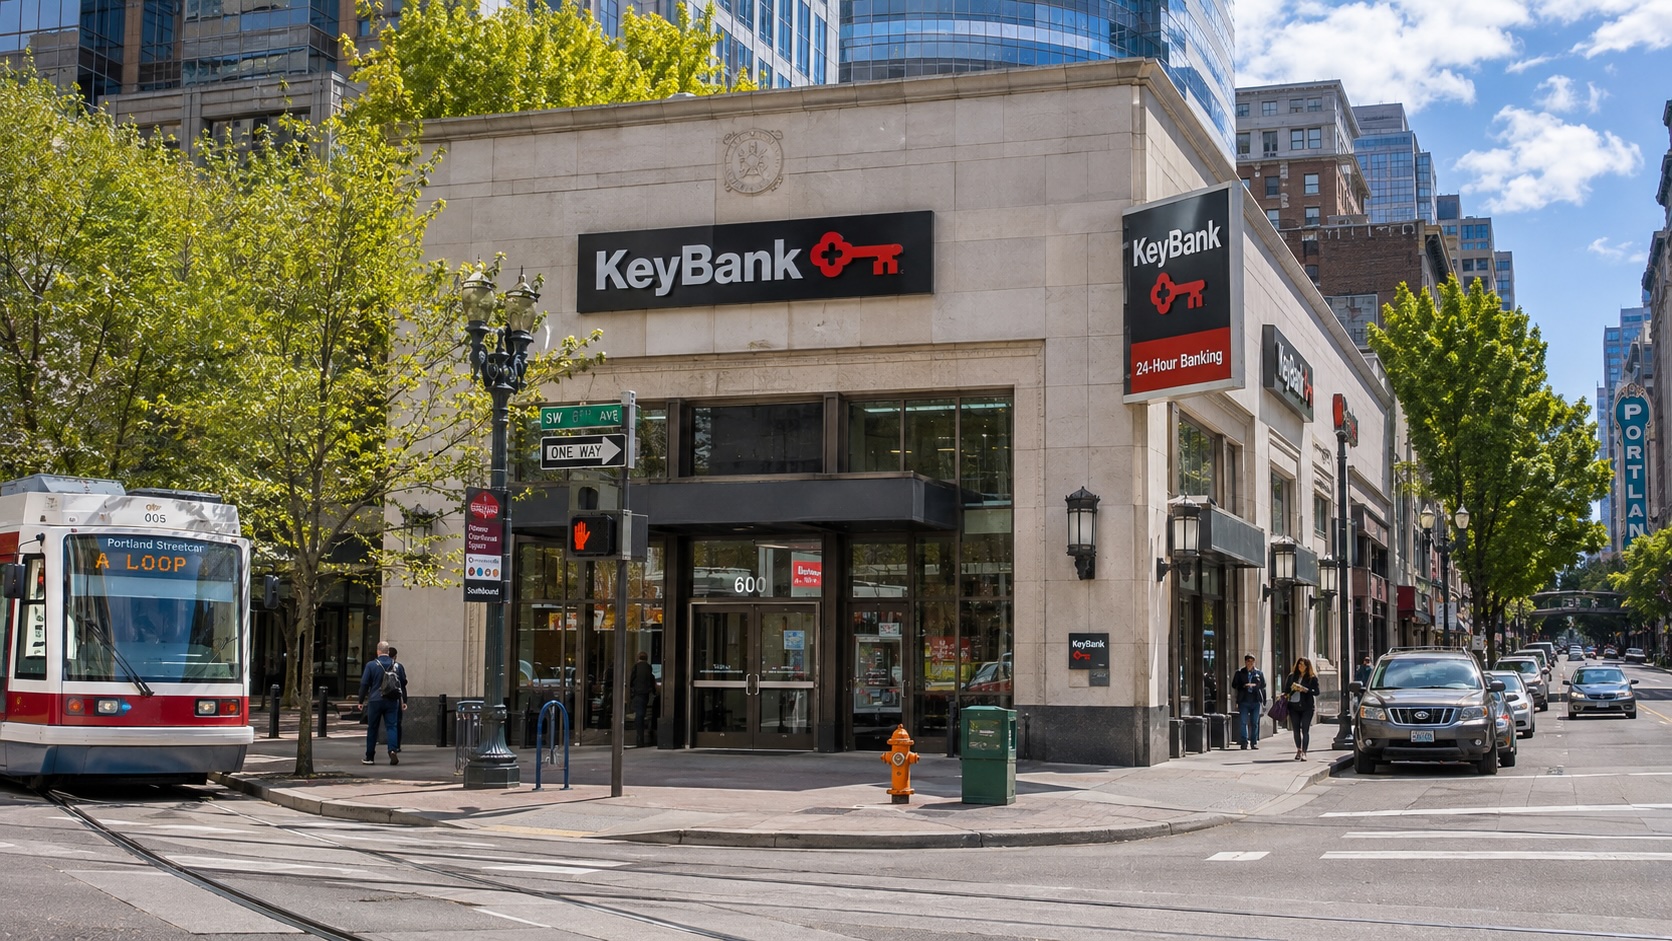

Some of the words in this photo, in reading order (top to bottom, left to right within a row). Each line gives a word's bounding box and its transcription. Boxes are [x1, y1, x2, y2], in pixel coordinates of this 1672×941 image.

[1132, 219, 1222, 268] KeyBank
[595, 238, 803, 297] KeyBank
[1136, 358, 1178, 376] 24-Hour
[1180, 349, 1223, 369] Banking
[545, 412, 563, 424] SW
[600, 409, 619, 422] AVE
[551, 446, 573, 459] ONE
[580, 445, 602, 458] WAY
[1623, 403, 1644, 539] PORTLAN
[144, 512, 167, 523] 005
[107, 538, 153, 550] Portland
[156, 540, 205, 553] Streetcar
[95, 552, 110, 569] A
[126, 553, 187, 573] LOOP
[734, 576, 767, 593] 600
[1072, 640, 1105, 650] KeyBank
